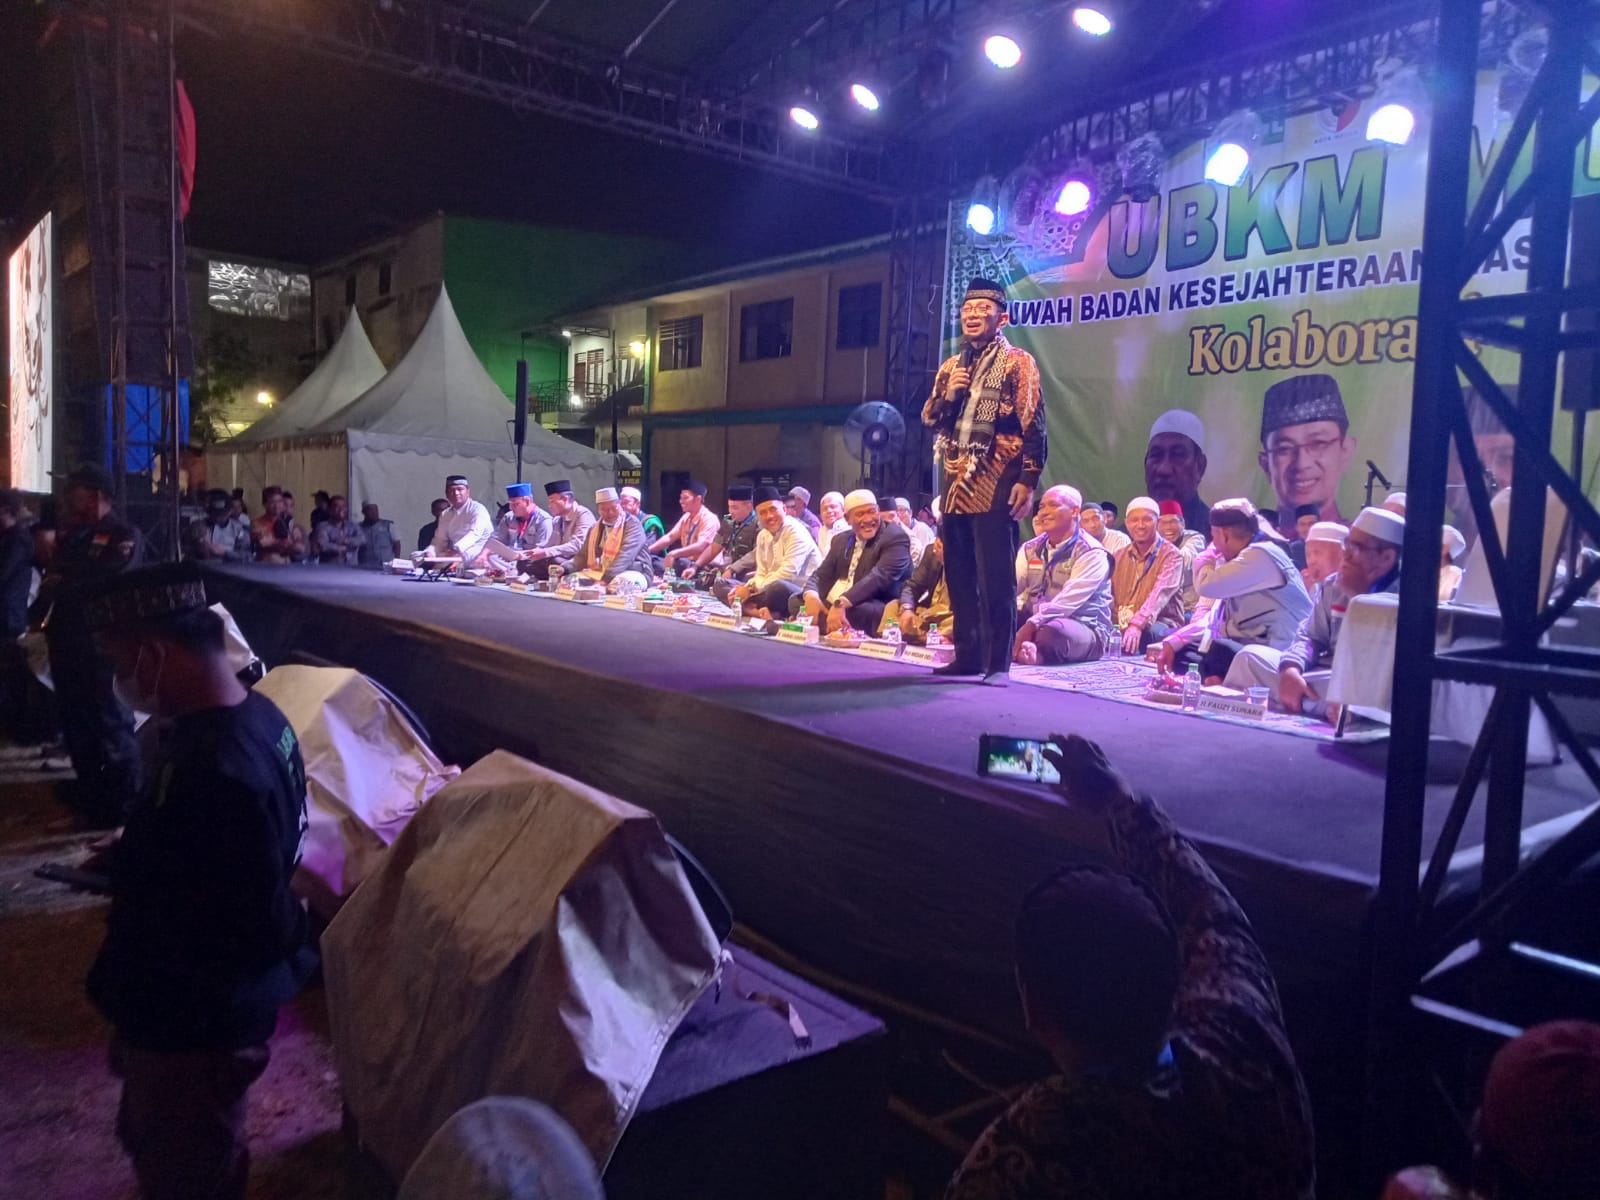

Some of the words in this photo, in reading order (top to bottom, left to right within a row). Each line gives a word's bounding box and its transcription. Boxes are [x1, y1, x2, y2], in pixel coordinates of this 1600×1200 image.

[1106, 147, 1389, 280] UBKM
[1008, 296, 1073, 326] UWAH
[1080, 286, 1162, 321] BADAN
[1188, 308, 1418, 376] Kolabora
